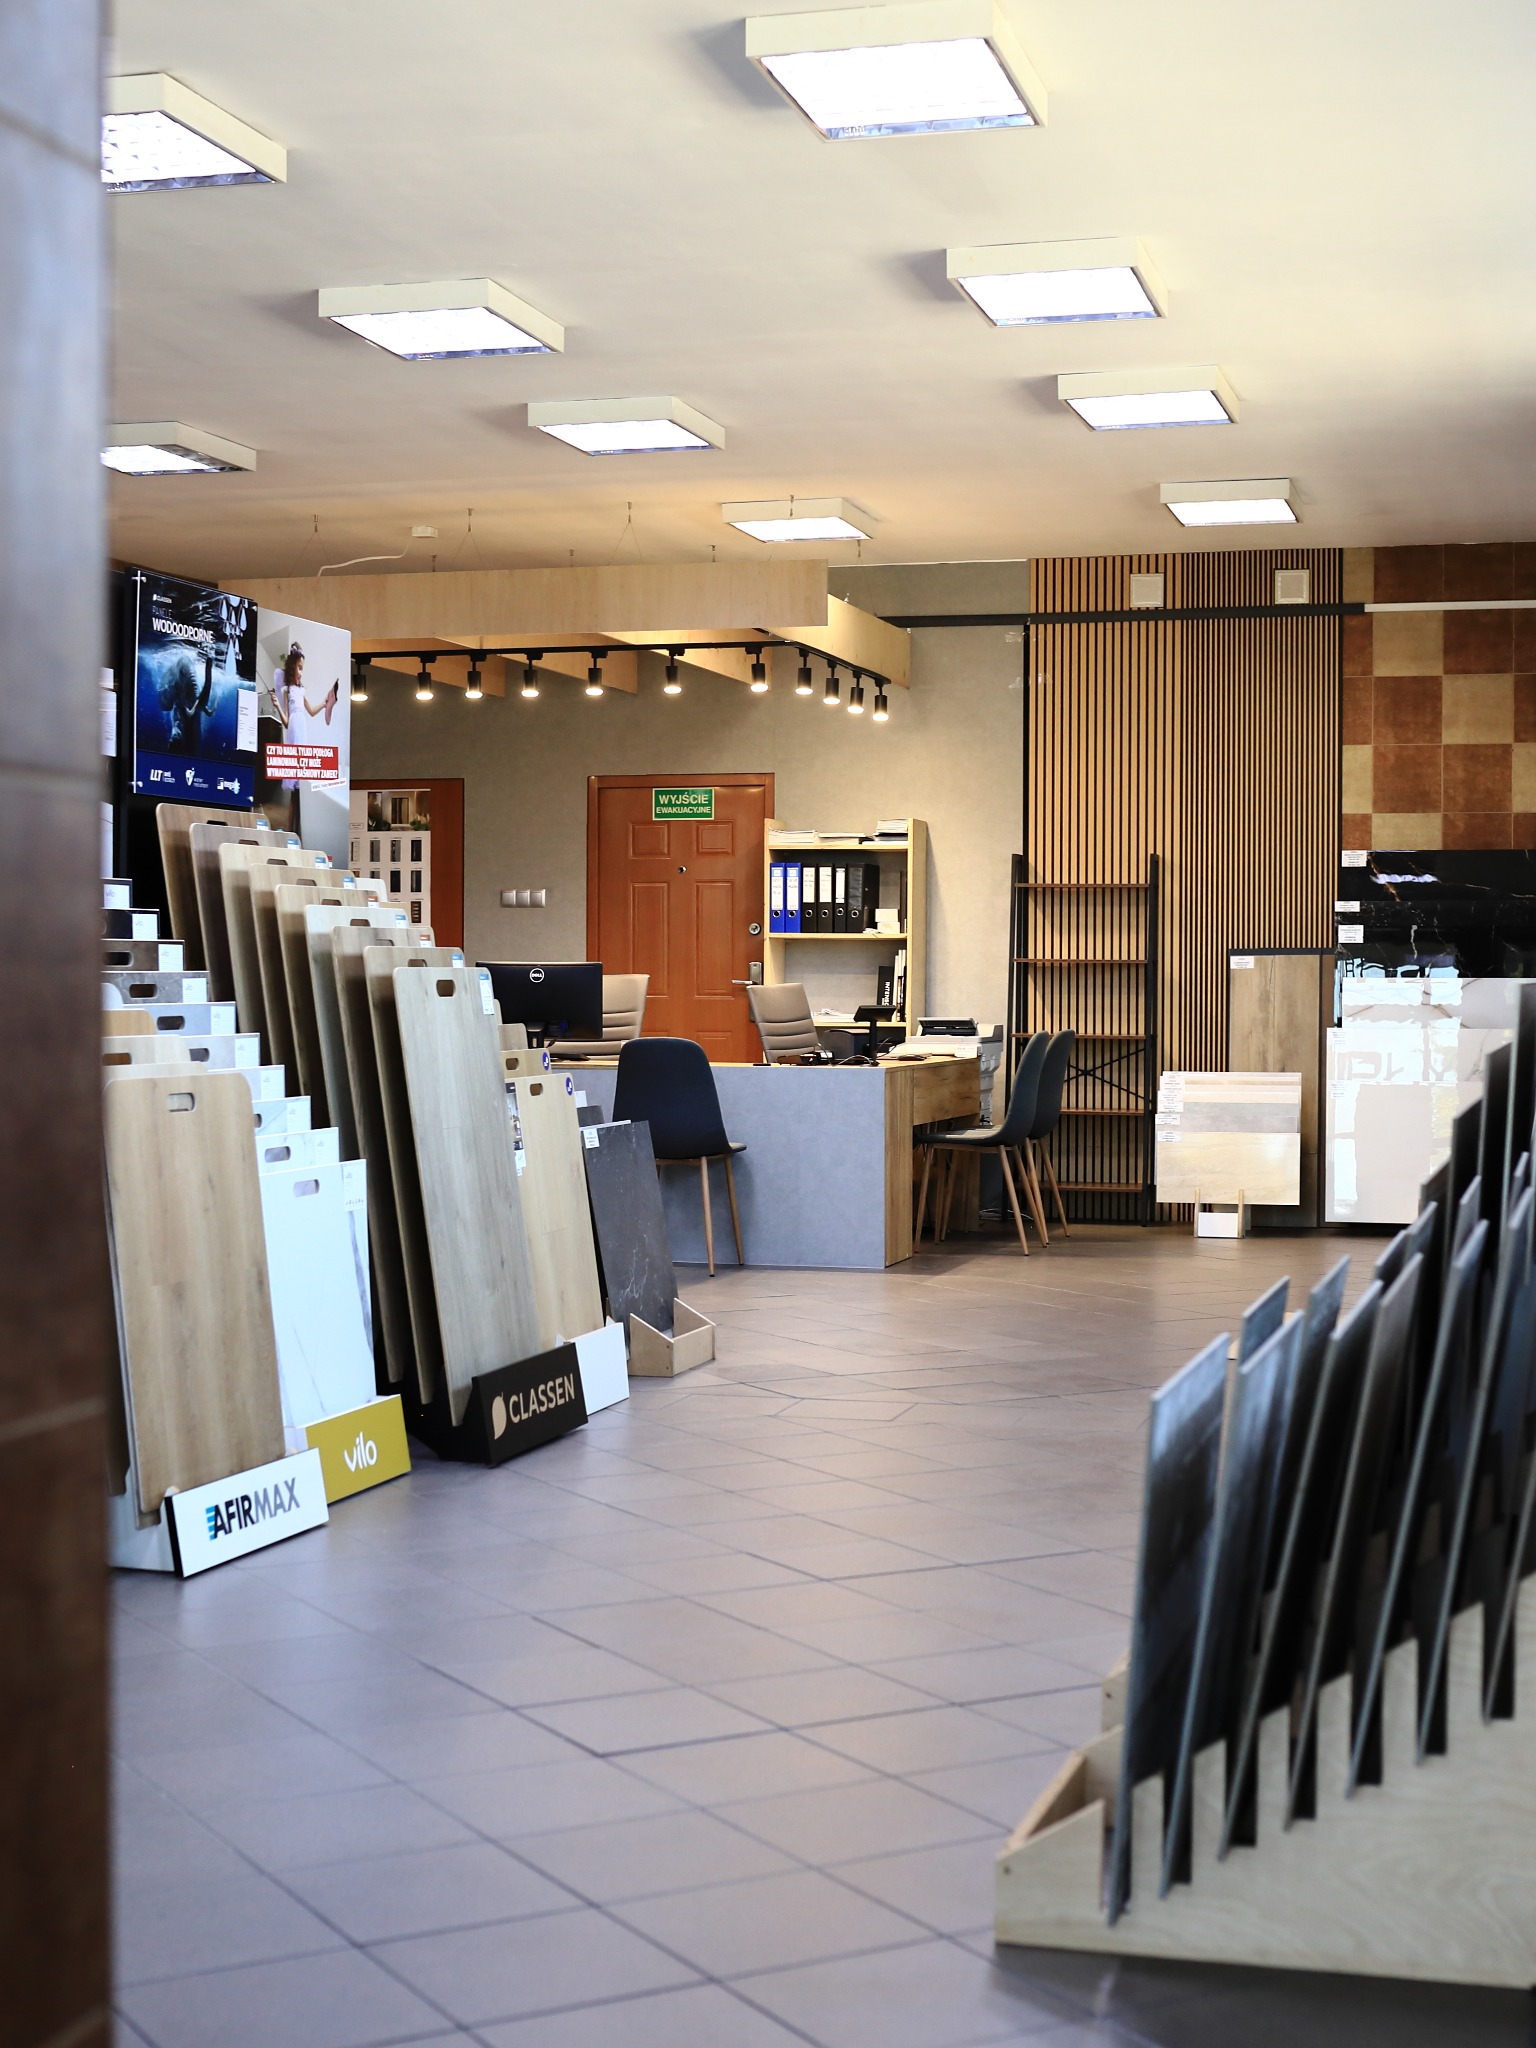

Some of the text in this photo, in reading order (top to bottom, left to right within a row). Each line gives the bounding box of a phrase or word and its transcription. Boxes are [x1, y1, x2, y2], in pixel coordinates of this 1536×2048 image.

[152, 617, 214, 643] WODOODPORNE
[656, 806, 711, 814] EWAKUACYJNE
[658, 791, 709, 804] WYJŚCIE
[509, 1373, 575, 1423] CLASSEN
[343, 1431, 378, 1472] vilo
[206, 1477, 300, 1541] AFIRMAX
